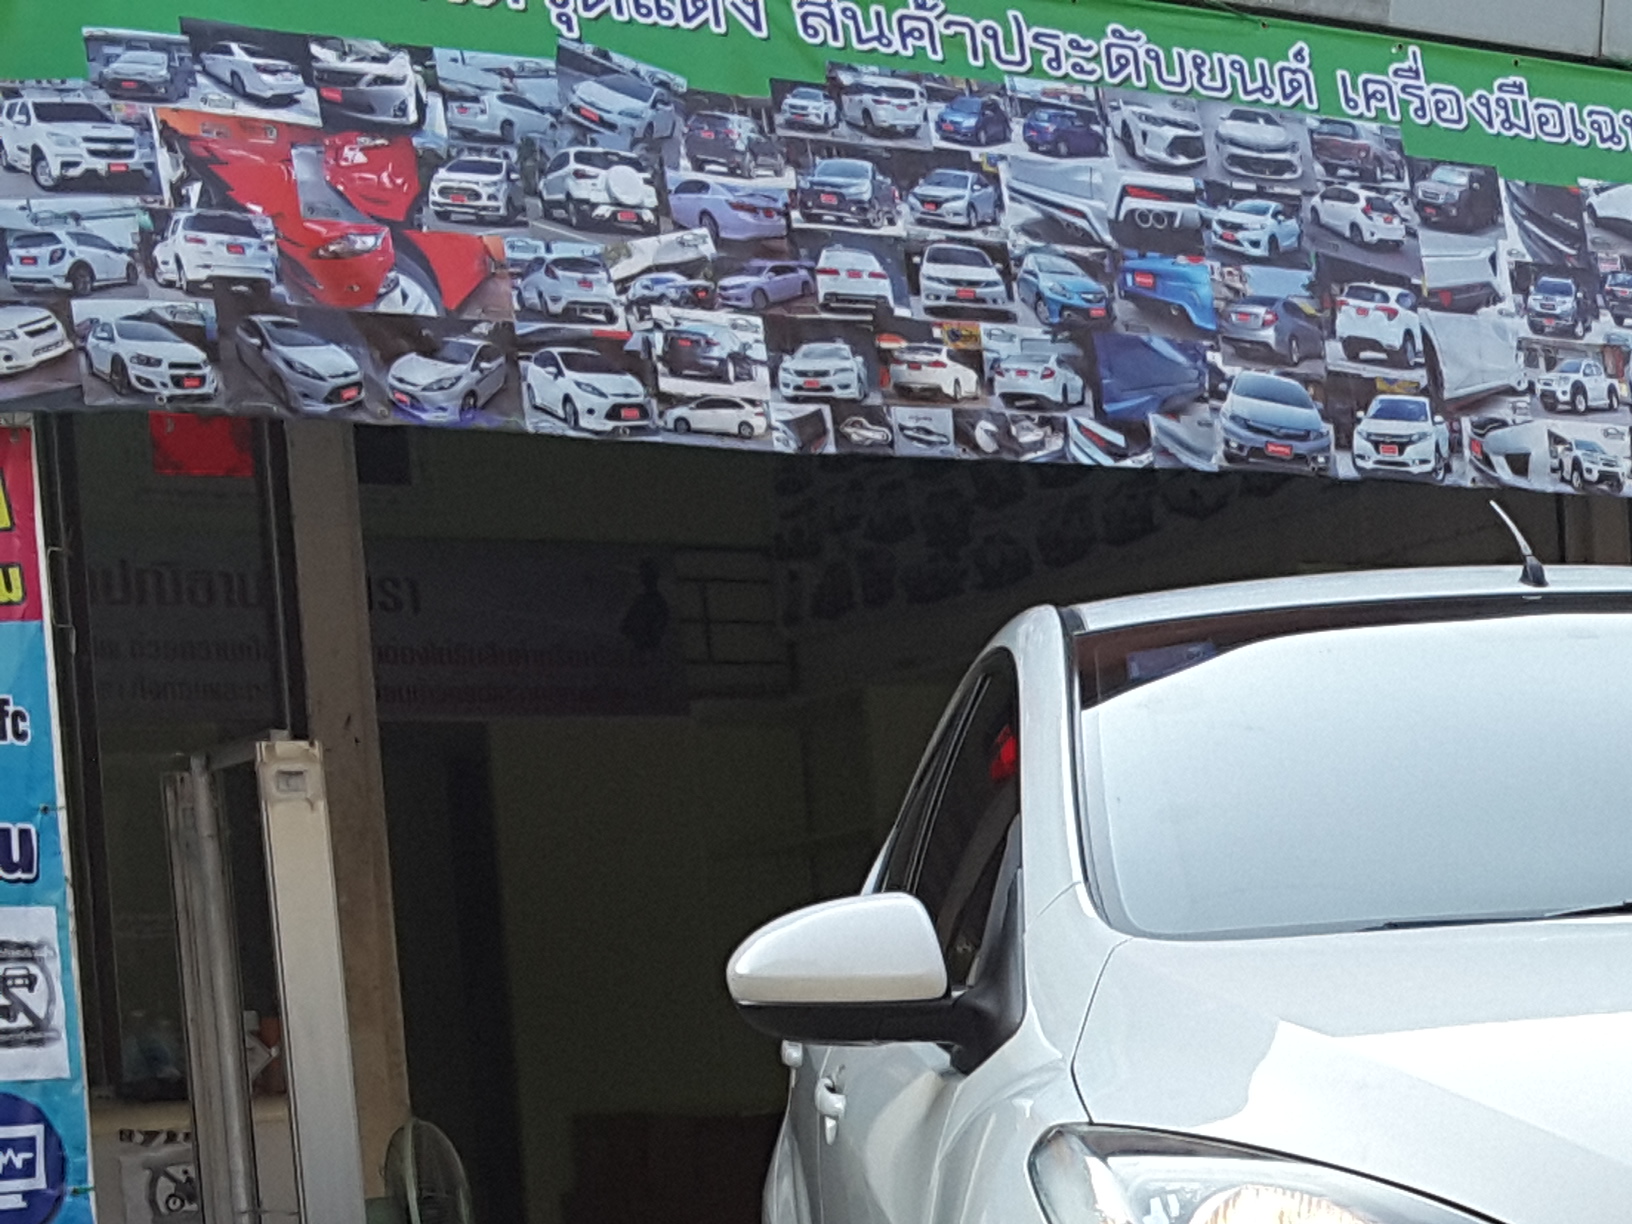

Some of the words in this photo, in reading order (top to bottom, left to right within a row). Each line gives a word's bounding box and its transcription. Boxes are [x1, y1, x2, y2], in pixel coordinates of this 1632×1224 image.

[797, 0, 1318, 109] สนค้าประดับยนต์
